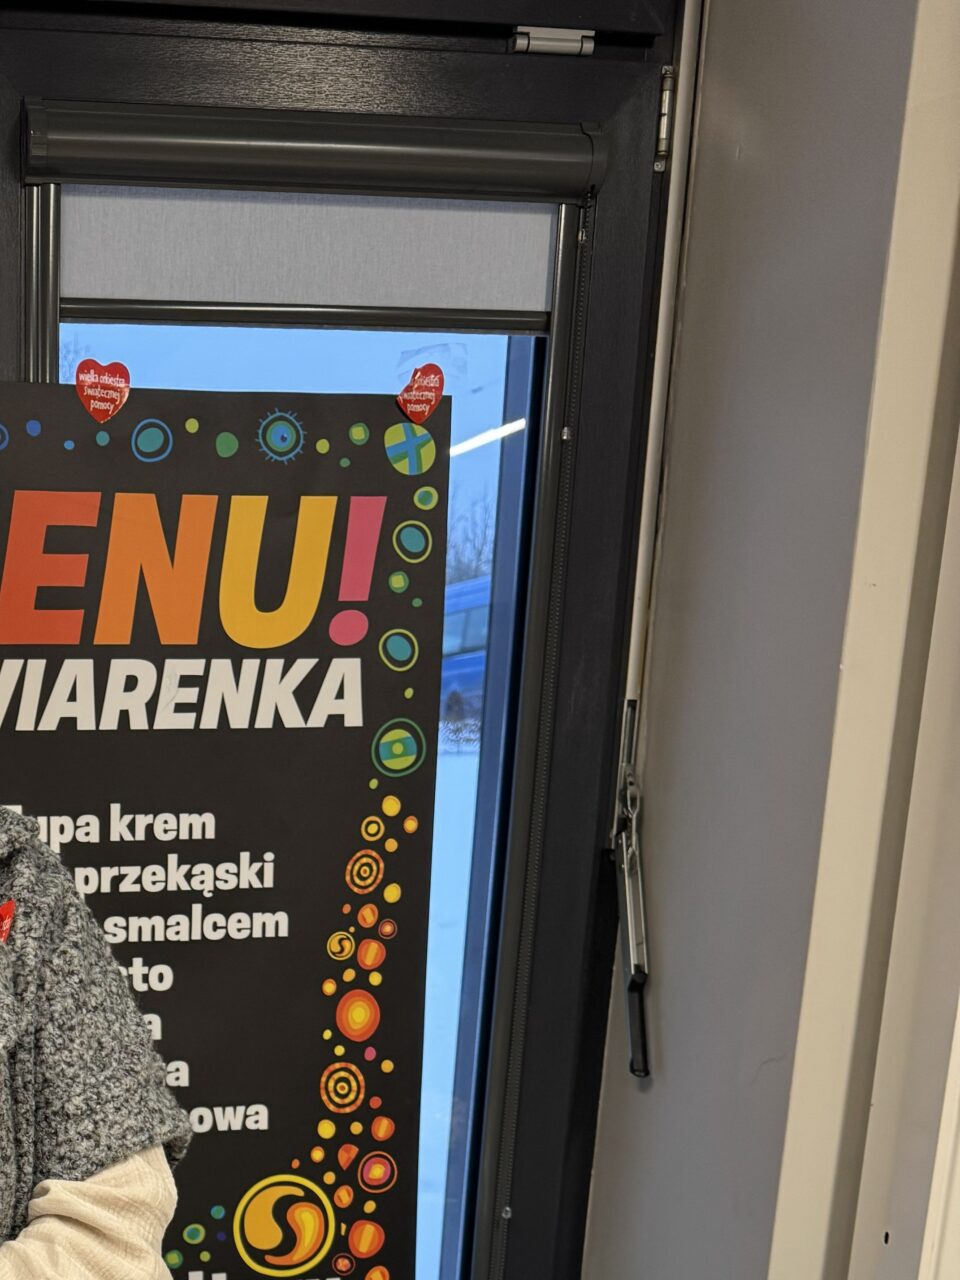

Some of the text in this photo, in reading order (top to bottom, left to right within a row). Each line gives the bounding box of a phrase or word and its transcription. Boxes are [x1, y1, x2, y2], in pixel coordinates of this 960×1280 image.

[79, 369, 98, 382] wielka
[91, 400, 114, 415] pomocy
[110, 803, 216, 842] krem
[74, 851, 275, 898] przekąski
[102, 903, 289, 944] smalcem
[189, 1103, 269, 1133] owa
